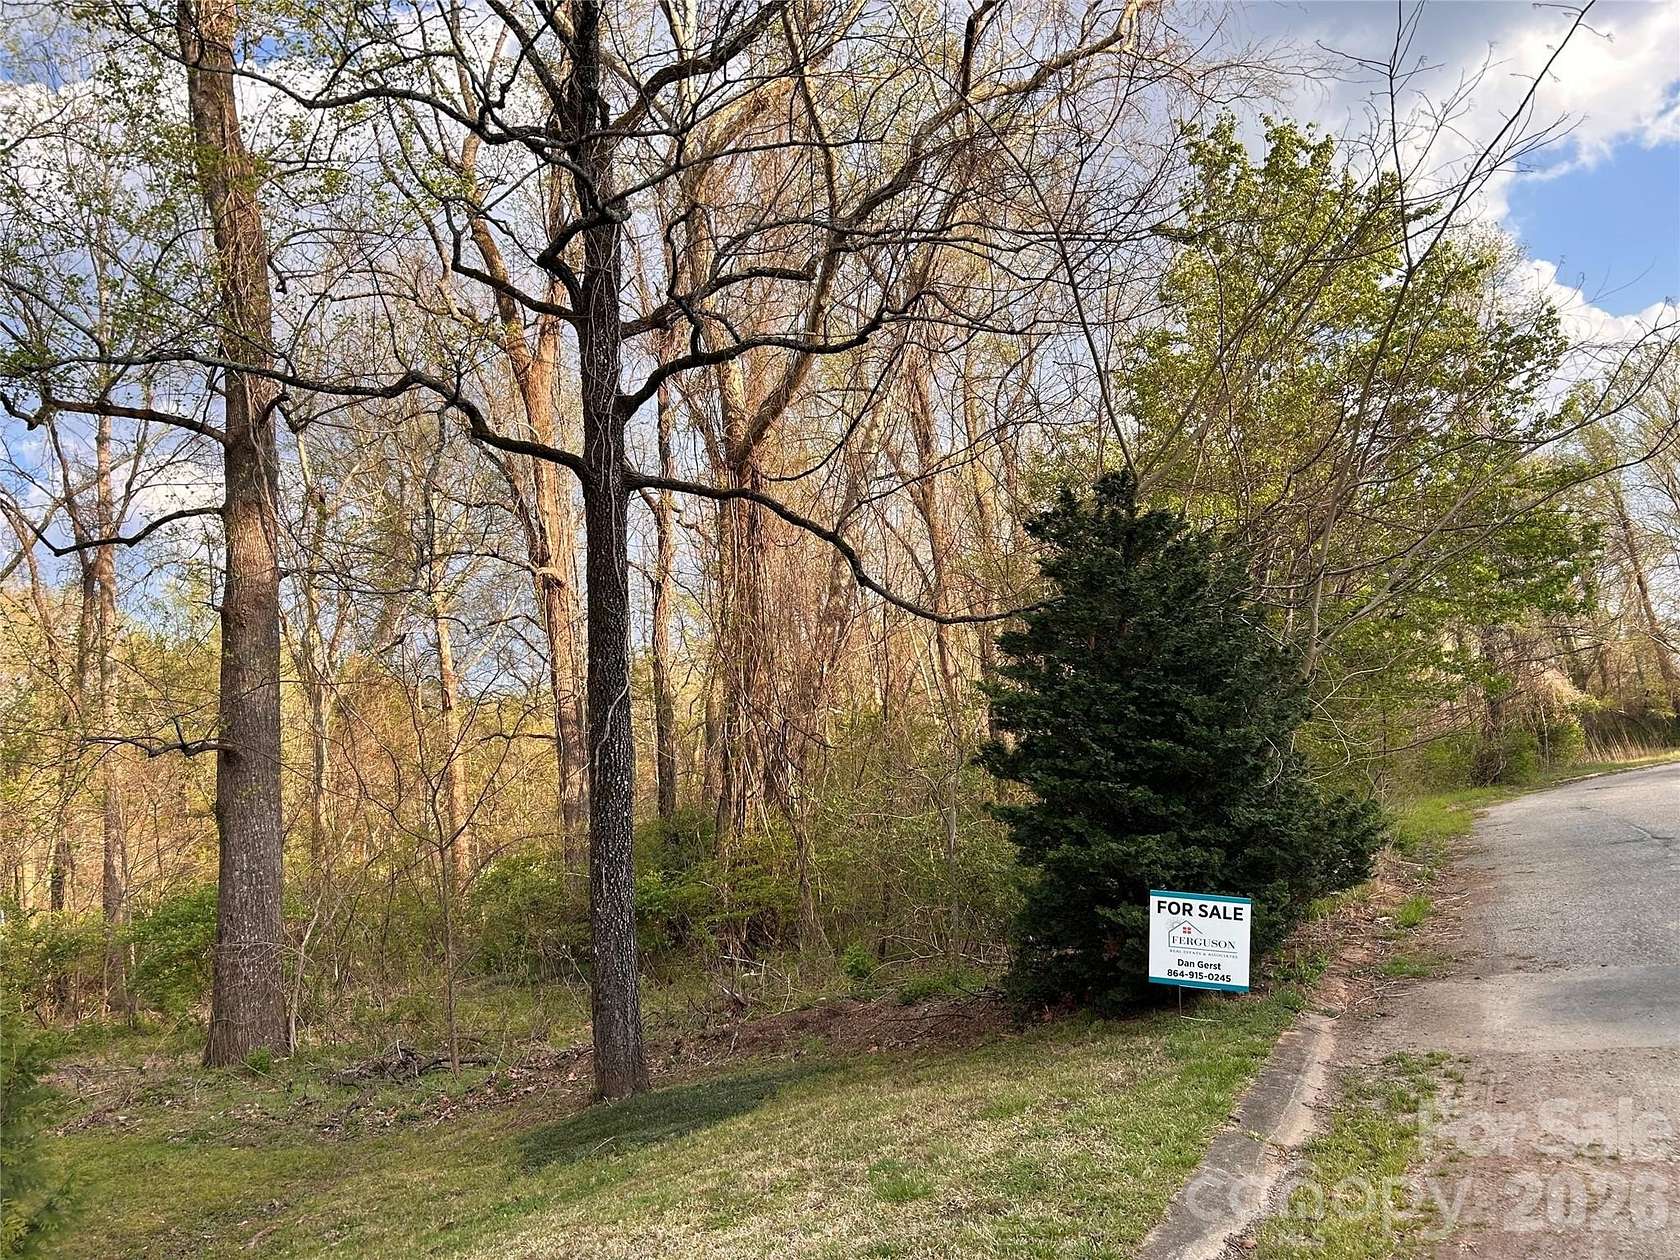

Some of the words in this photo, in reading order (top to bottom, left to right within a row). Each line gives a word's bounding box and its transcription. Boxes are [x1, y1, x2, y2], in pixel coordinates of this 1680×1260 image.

[1157, 900, 1193, 917] FOR
[1198, 904, 1244, 921] SALE
[1172, 935, 1236, 949] FERGUSON
[1177, 958, 1195, 968] Dan
[1197, 960, 1221, 970] Gerst
[1167, 968, 1232, 983] 864-915-0245
